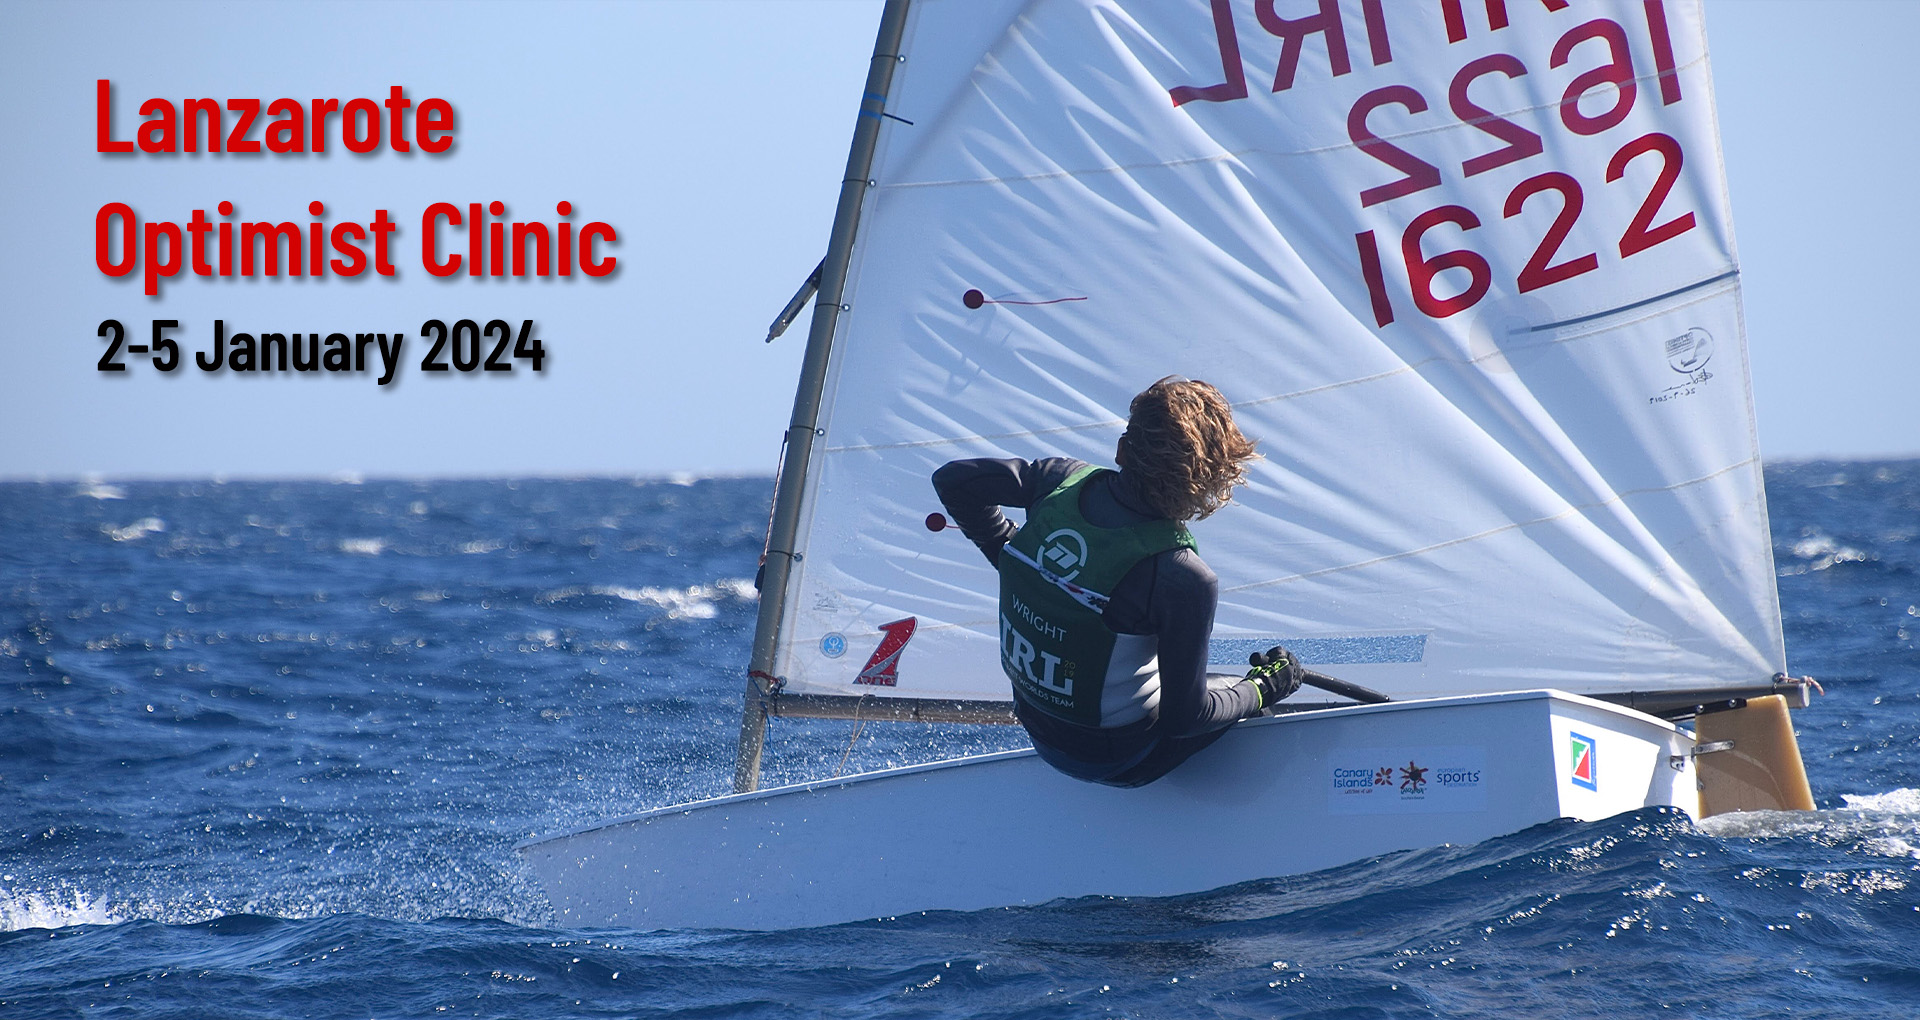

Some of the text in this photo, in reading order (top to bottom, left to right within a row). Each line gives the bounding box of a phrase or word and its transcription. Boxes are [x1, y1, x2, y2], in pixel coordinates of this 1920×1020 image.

[1355, 132, 1696, 329] 1622
[1012, 594, 1067, 642] WRIGHT
[1001, 612, 1073, 696] IRL
[1050, 695, 1075, 709] TEAM
[1334, 768, 1373, 779] Canary
[1436, 771, 1479, 786] sports
[1334, 778, 1373, 788] Islands
